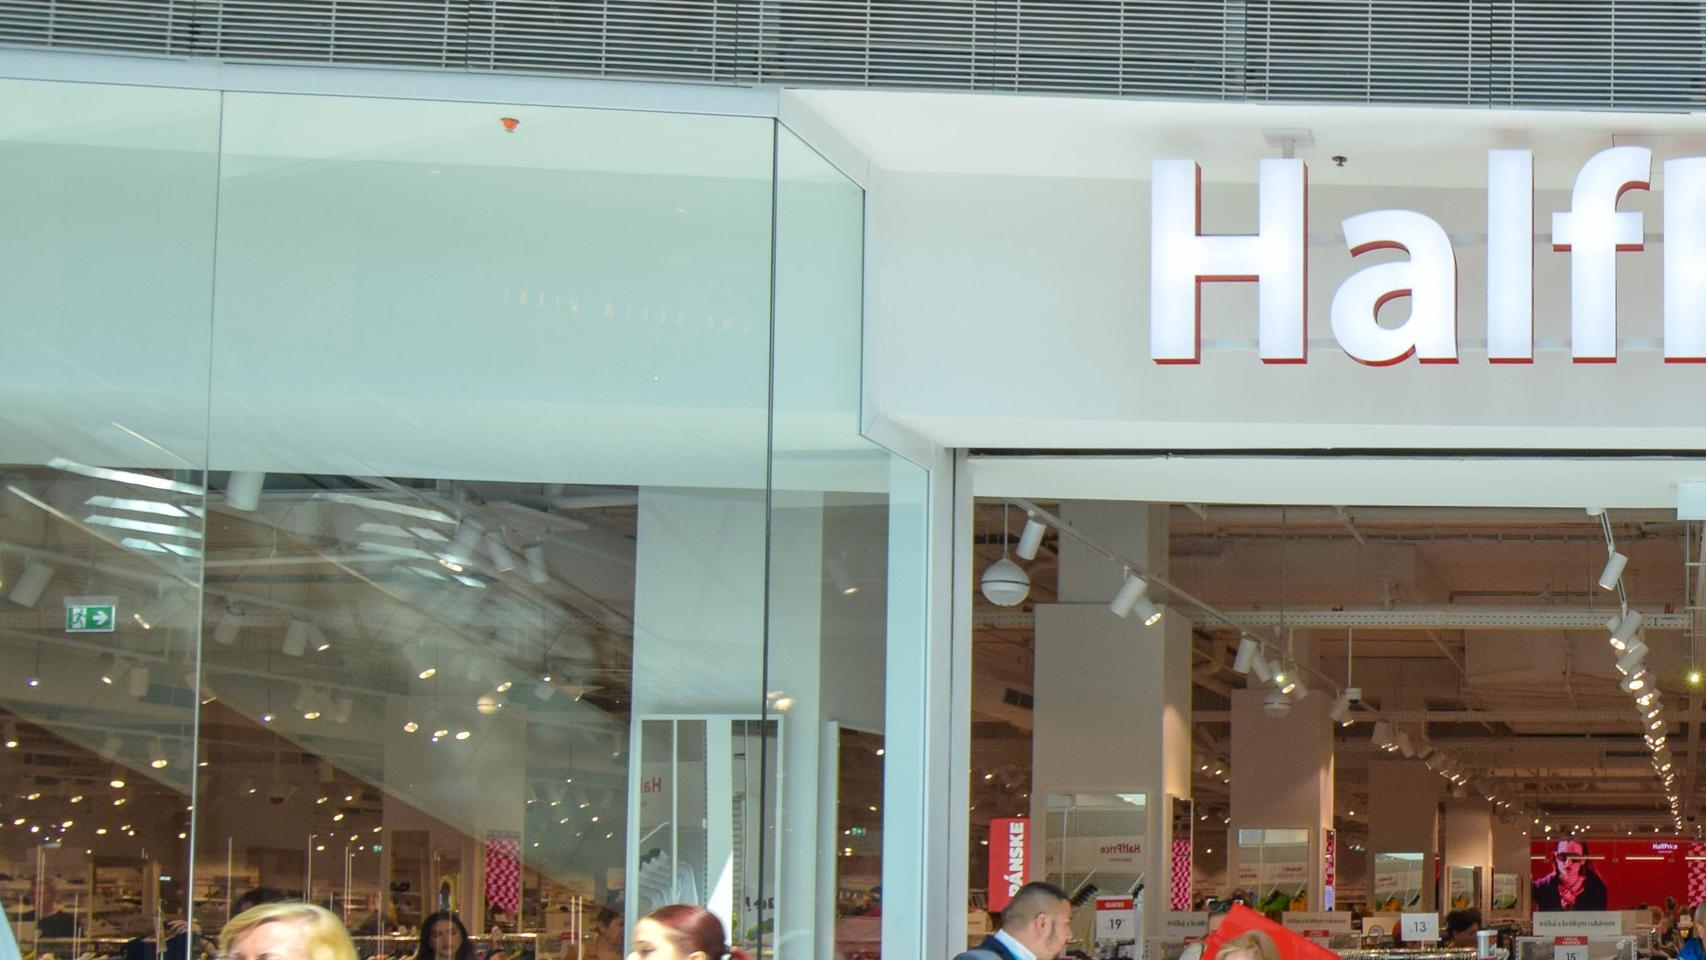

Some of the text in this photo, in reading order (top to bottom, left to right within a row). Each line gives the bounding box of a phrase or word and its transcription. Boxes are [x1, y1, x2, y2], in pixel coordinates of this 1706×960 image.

[1004, 822, 1024, 897] PÁNSKE
[1109, 918, 1123, 930] 19
[1413, 921, 1427, 933] 13
